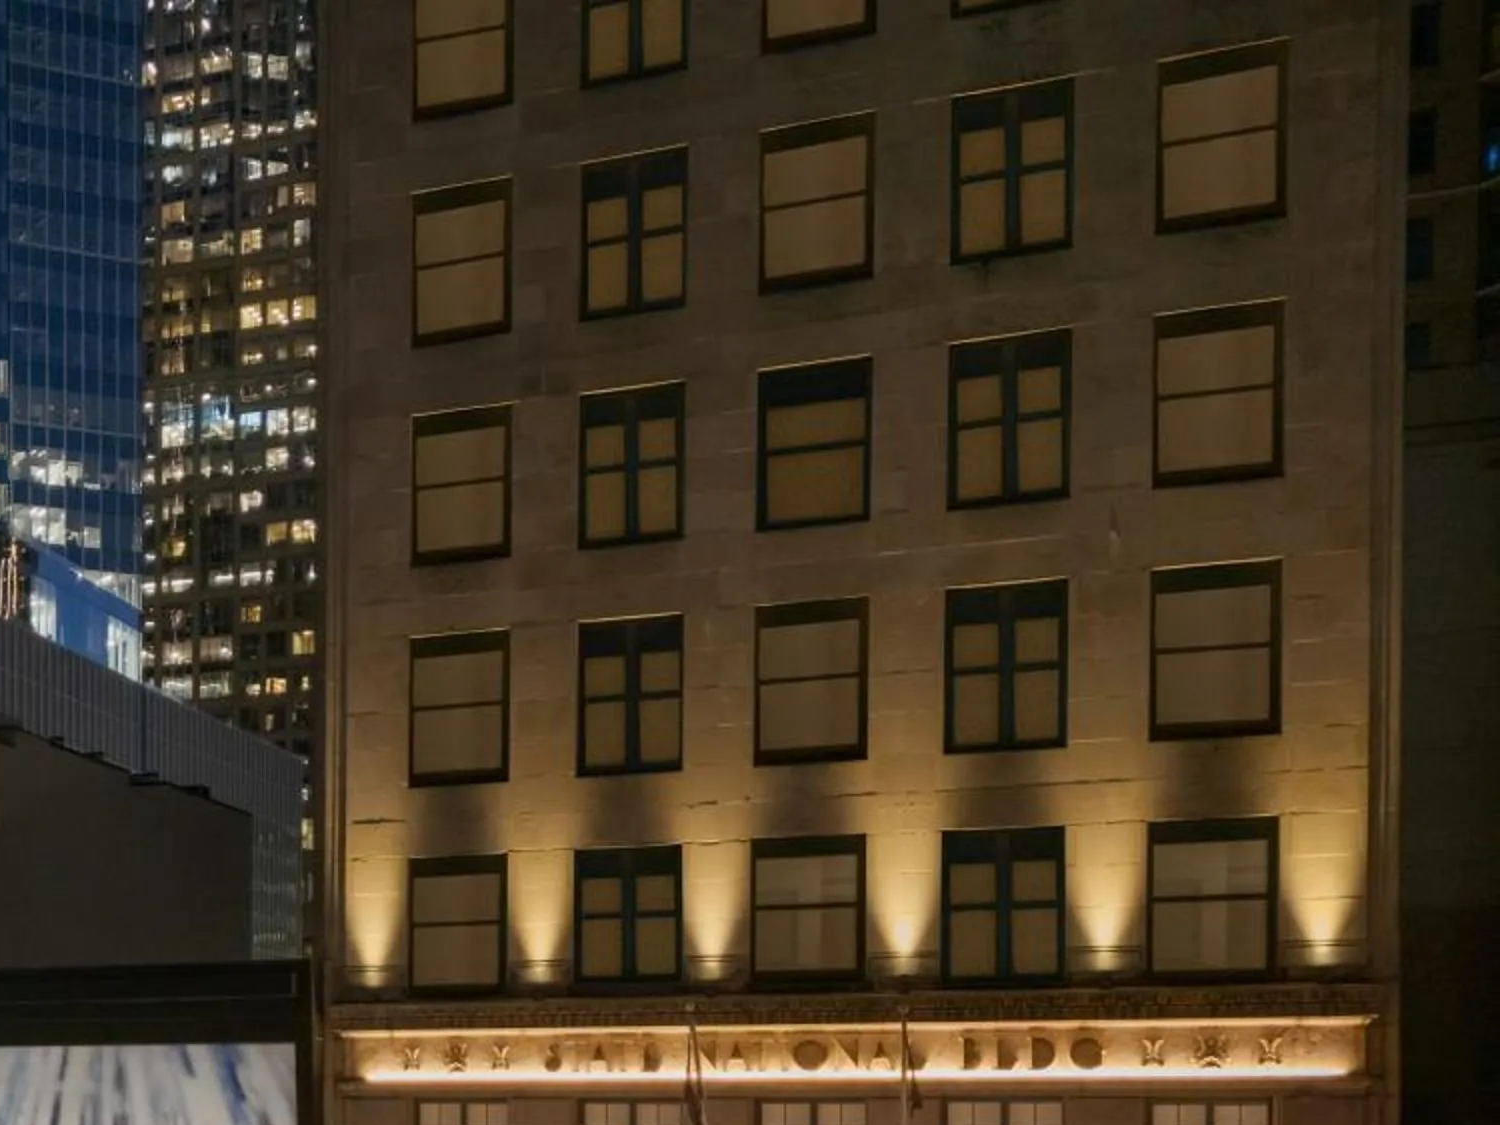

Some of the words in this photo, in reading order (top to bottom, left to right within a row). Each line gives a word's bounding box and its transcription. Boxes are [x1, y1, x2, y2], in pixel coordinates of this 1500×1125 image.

[543, 1039, 661, 1073] STATE
[697, 1037, 930, 1073] NATIONAL
[962, 1035, 1107, 1071] BLDG
